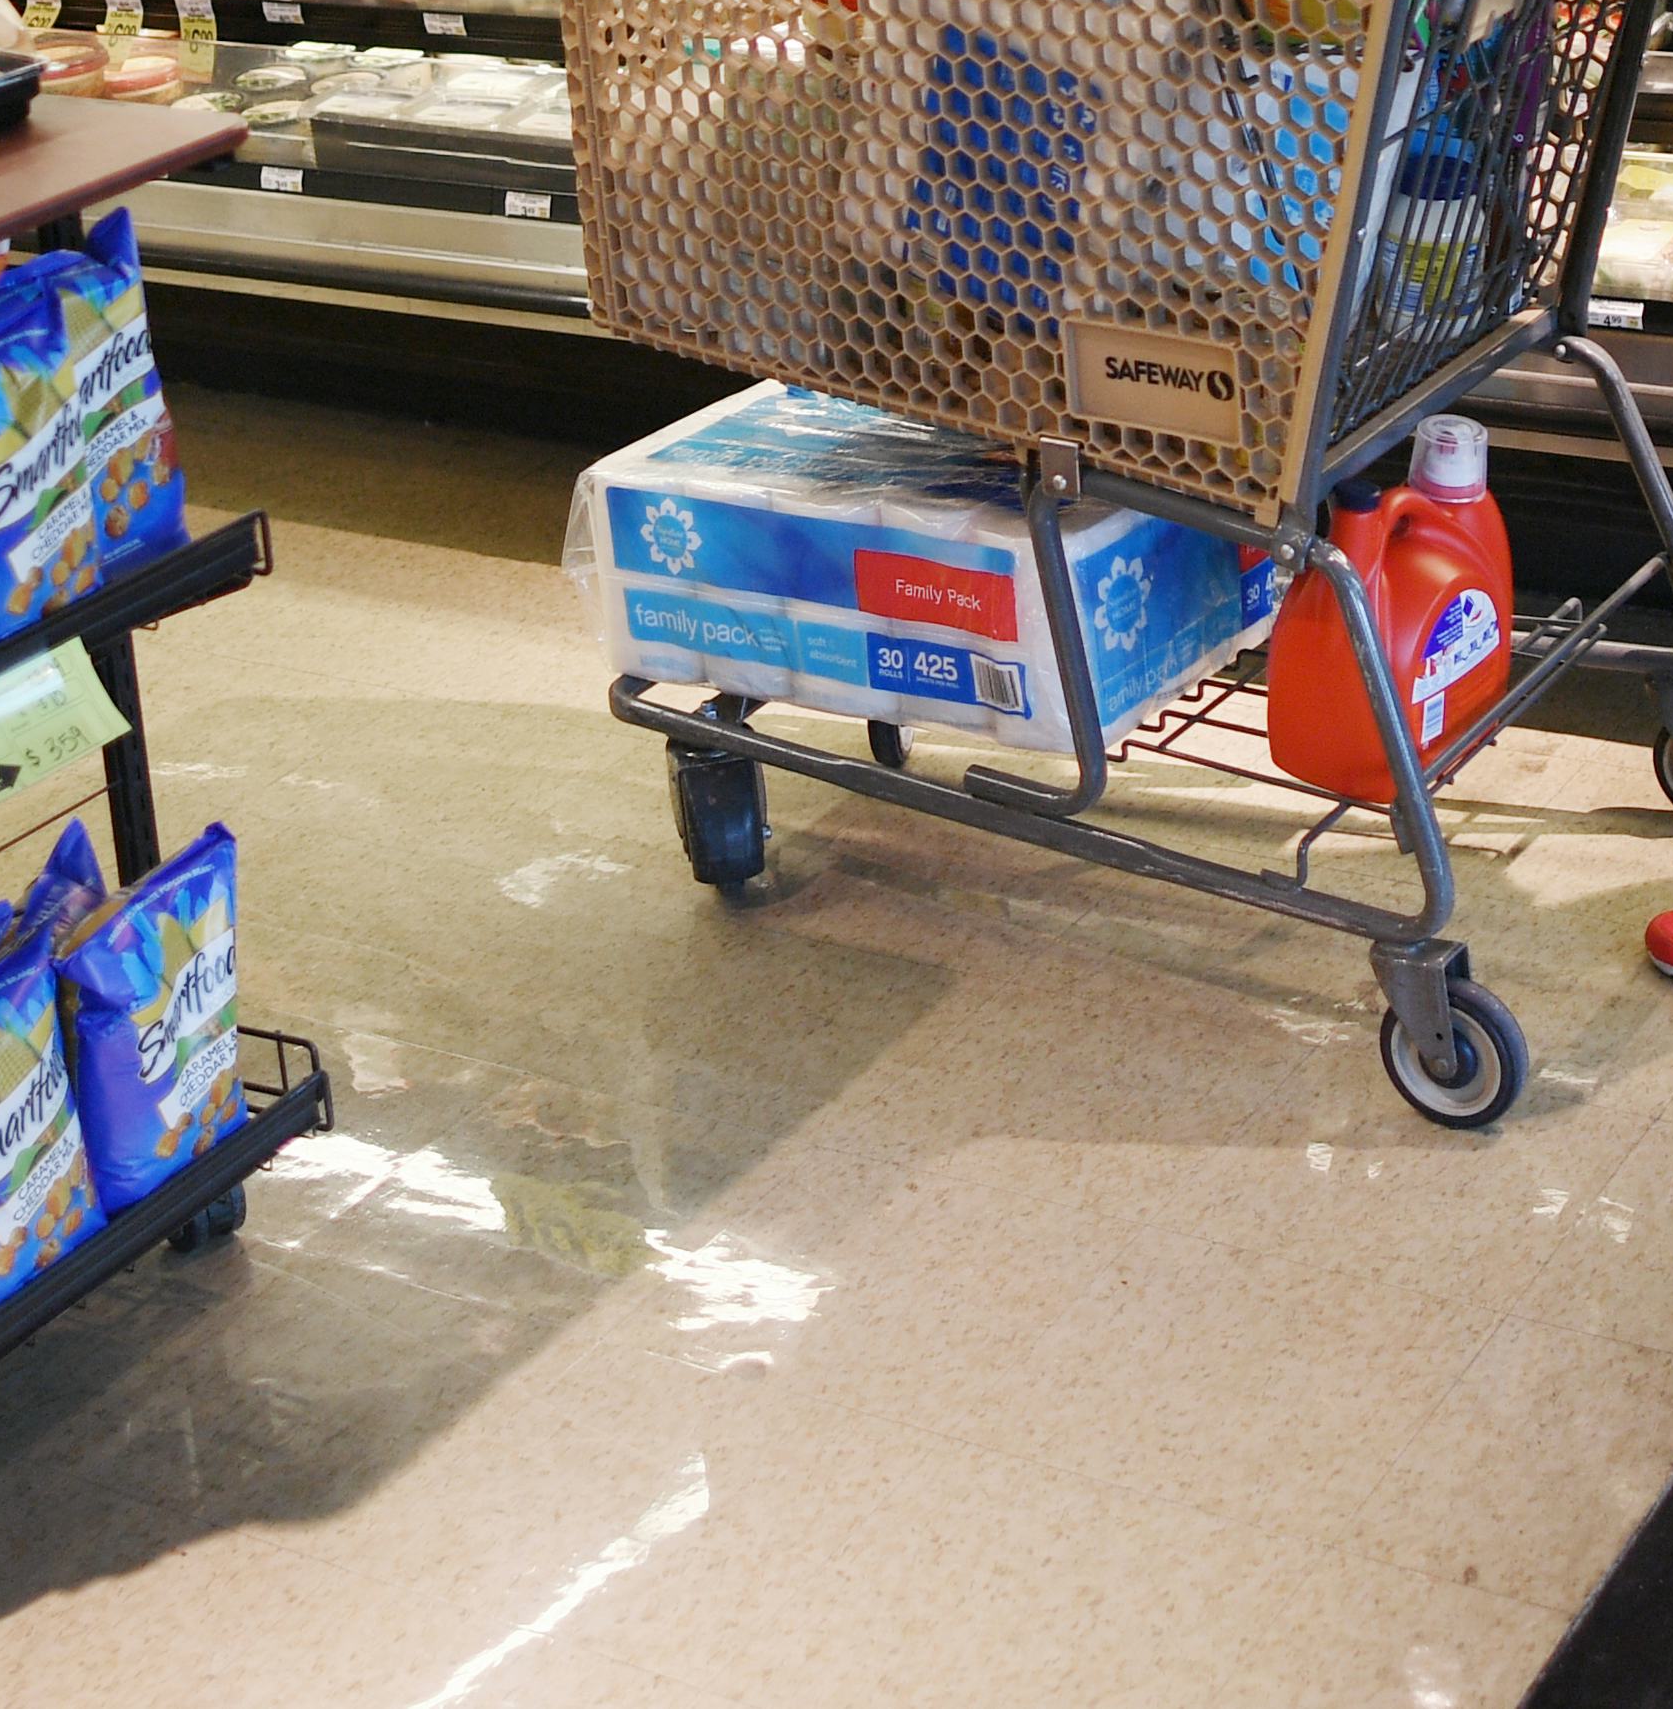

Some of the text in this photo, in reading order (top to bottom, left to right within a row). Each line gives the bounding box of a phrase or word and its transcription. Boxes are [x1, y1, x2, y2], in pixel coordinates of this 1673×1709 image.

[1603, 315, 1623, 327] 499
[1104, 356, 1204, 392] SAFEWAY
[895, 578, 982, 612] Family Pack
[1245, 583, 1262, 606] 30
[635, 602, 759, 650] family pack
[807, 636, 825, 648] soft
[877, 647, 959, 682] 30 425
[877, 668, 904, 680] ROLLS
[26, 748, 41, 767] $
[179, 1056, 227, 1109] CHEDDAR
[180, 1044, 227, 1088] CARAMEL
